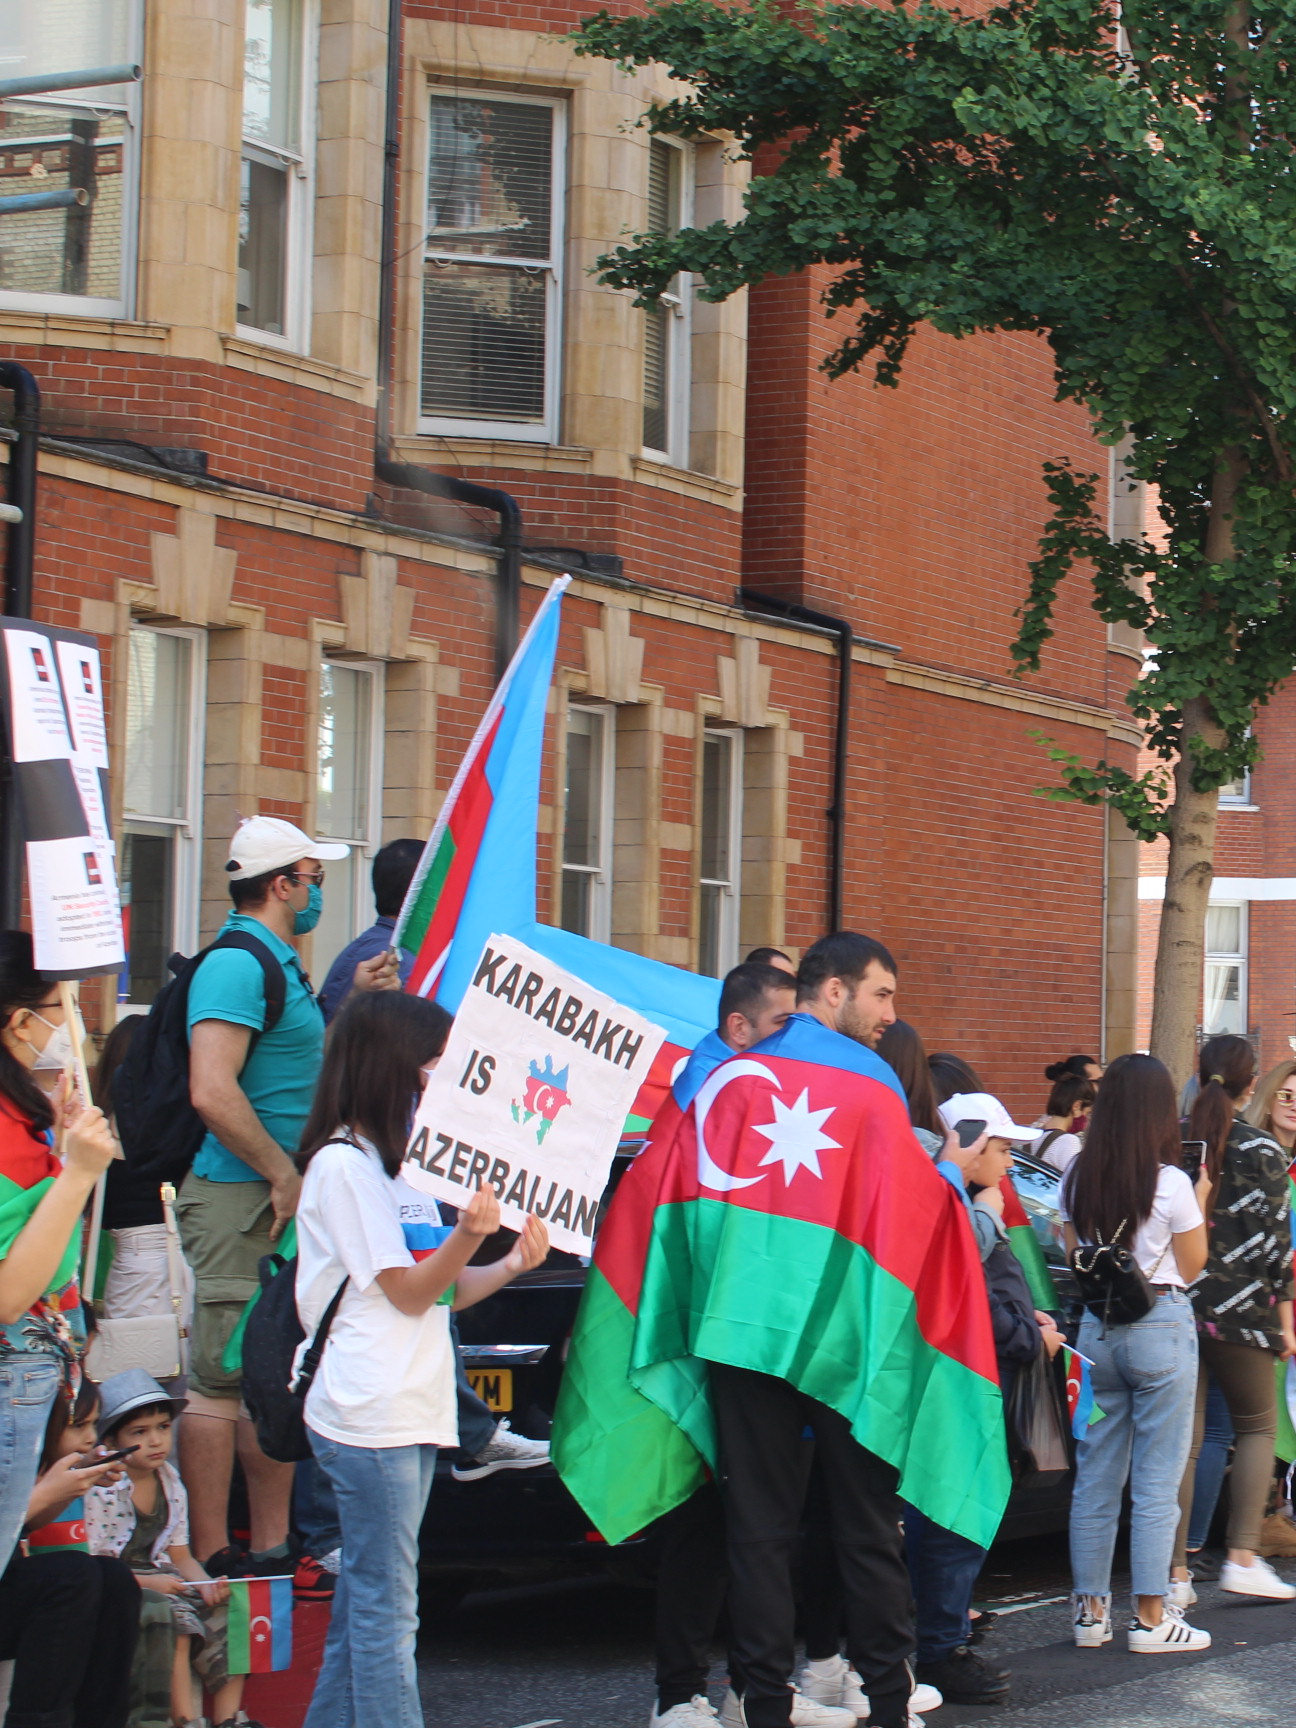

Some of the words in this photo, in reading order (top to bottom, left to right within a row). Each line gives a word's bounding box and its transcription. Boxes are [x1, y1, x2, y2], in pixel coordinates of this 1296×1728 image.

[473, 947, 645, 1070] KARABAKH
[459, 1049, 497, 1096] IS
[402, 1125, 599, 1238] AZERBAIJAN
